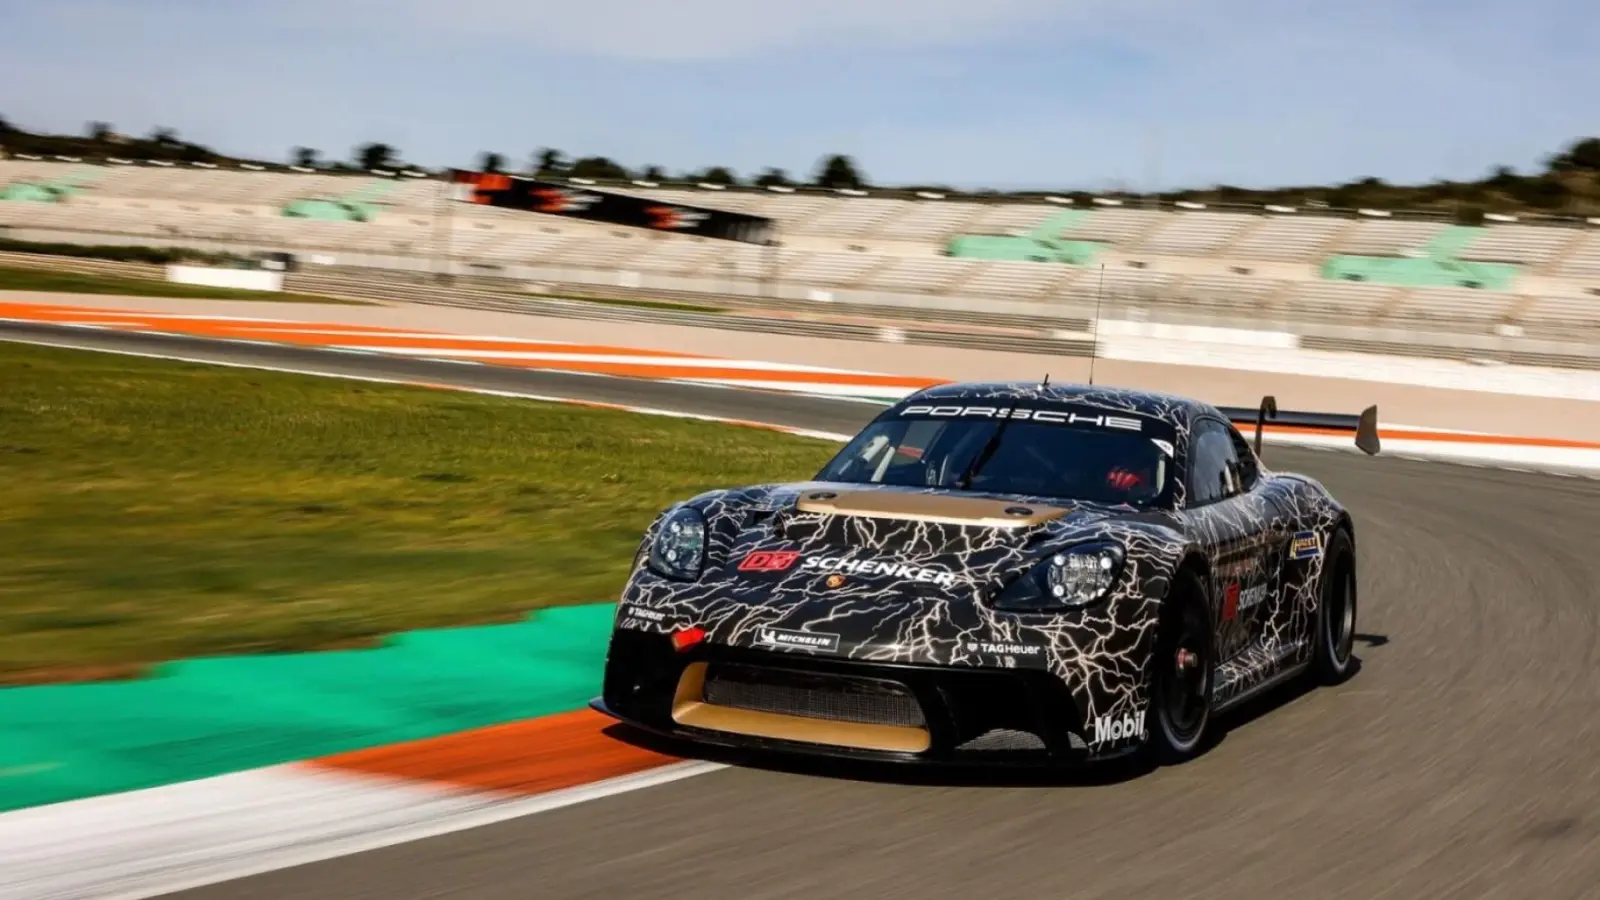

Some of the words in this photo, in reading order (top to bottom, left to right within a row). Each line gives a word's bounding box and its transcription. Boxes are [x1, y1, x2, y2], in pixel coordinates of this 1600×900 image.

[900, 406, 1142, 431] PORSCHE
[801, 556, 955, 586] SCHENKER
[777, 634, 832, 646] MICHELIN
[1095, 710, 1146, 743] Mobil
